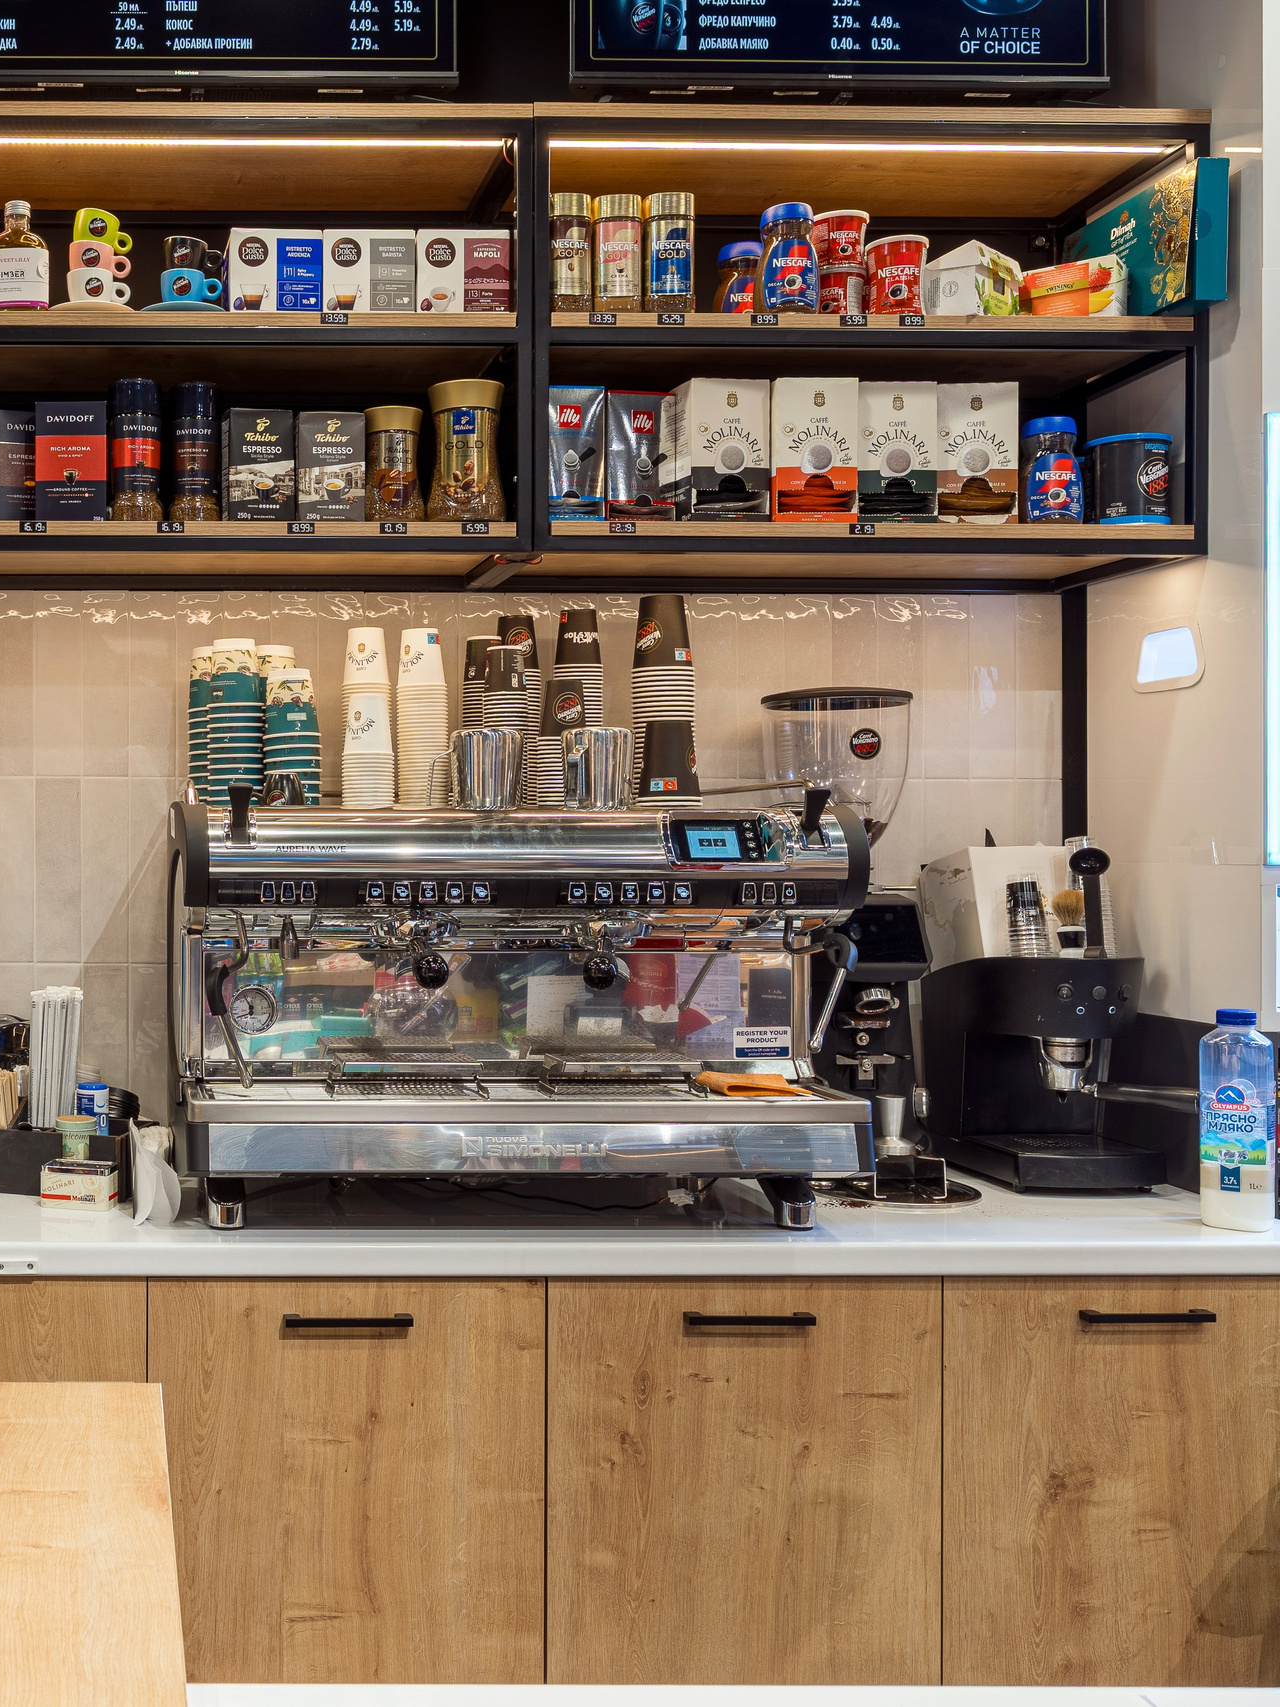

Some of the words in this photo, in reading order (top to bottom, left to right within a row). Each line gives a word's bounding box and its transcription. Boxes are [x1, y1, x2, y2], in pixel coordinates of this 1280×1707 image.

[165, 0, 197, 12] ПЪПЕШ
[165, 19, 193, 31] КОКОС
[699, 15, 729, 28] ФРЕДО
[730, 16, 777, 28] КАПУЧИНО
[960, 27, 969, 39] A
[976, 27, 1041, 39] MATTER
[173, 38, 213, 51] ДОБАВКА
[214, 38, 253, 50] ПРОТЕИН
[699, 38, 739, 50] ДОБАВКА
[740, 38, 769, 50] МЛЯКО
[960, 41, 979, 55] OF
[984, 41, 1041, 55] CHOICE
[1110, 217, 1136, 241] Dilmah
[558, 249, 585, 258] GOLD
[658, 249, 687, 259] GOLD
[1045, 282, 1075, 294] TWININGS
[46, 414, 95, 423] DAVIDOFF
[560, 408, 580, 426] illy
[633, 414, 652, 432] illy
[123, 424, 158, 433] DAVIDOFF
[176, 428, 212, 436] DAVIDOFF
[453, 423, 475, 432] Tchibo
[244, 432, 279, 443] Tchibo
[314, 432, 351, 444] Tchibo
[703, 425, 762, 453] MOLINARI
[788, 425, 850, 453] MOLINARI
[868, 429, 929, 457] MOLINARI
[944, 429, 1009, 457] MOLINARI
[242, 445, 283, 455] ESPRESSO
[312, 445, 353, 455] ESPRESSO
[386, 446, 411, 455] Tchibo
[444, 440, 485, 451] GOLD
[383, 455, 413, 466] GOLD
[275, 845, 317, 853] AURELIA
[318, 845, 347, 853] WAVE
[1211, 1102, 1248, 1111] OLYMPUS
[1206, 1113, 1257, 1125] ПРЯСНО
[1208, 1122, 1254, 1133] МЛЯКО
[487, 1143, 607, 1157] SIMONELLI
[41, 1179, 75, 1194] MOLINARI
